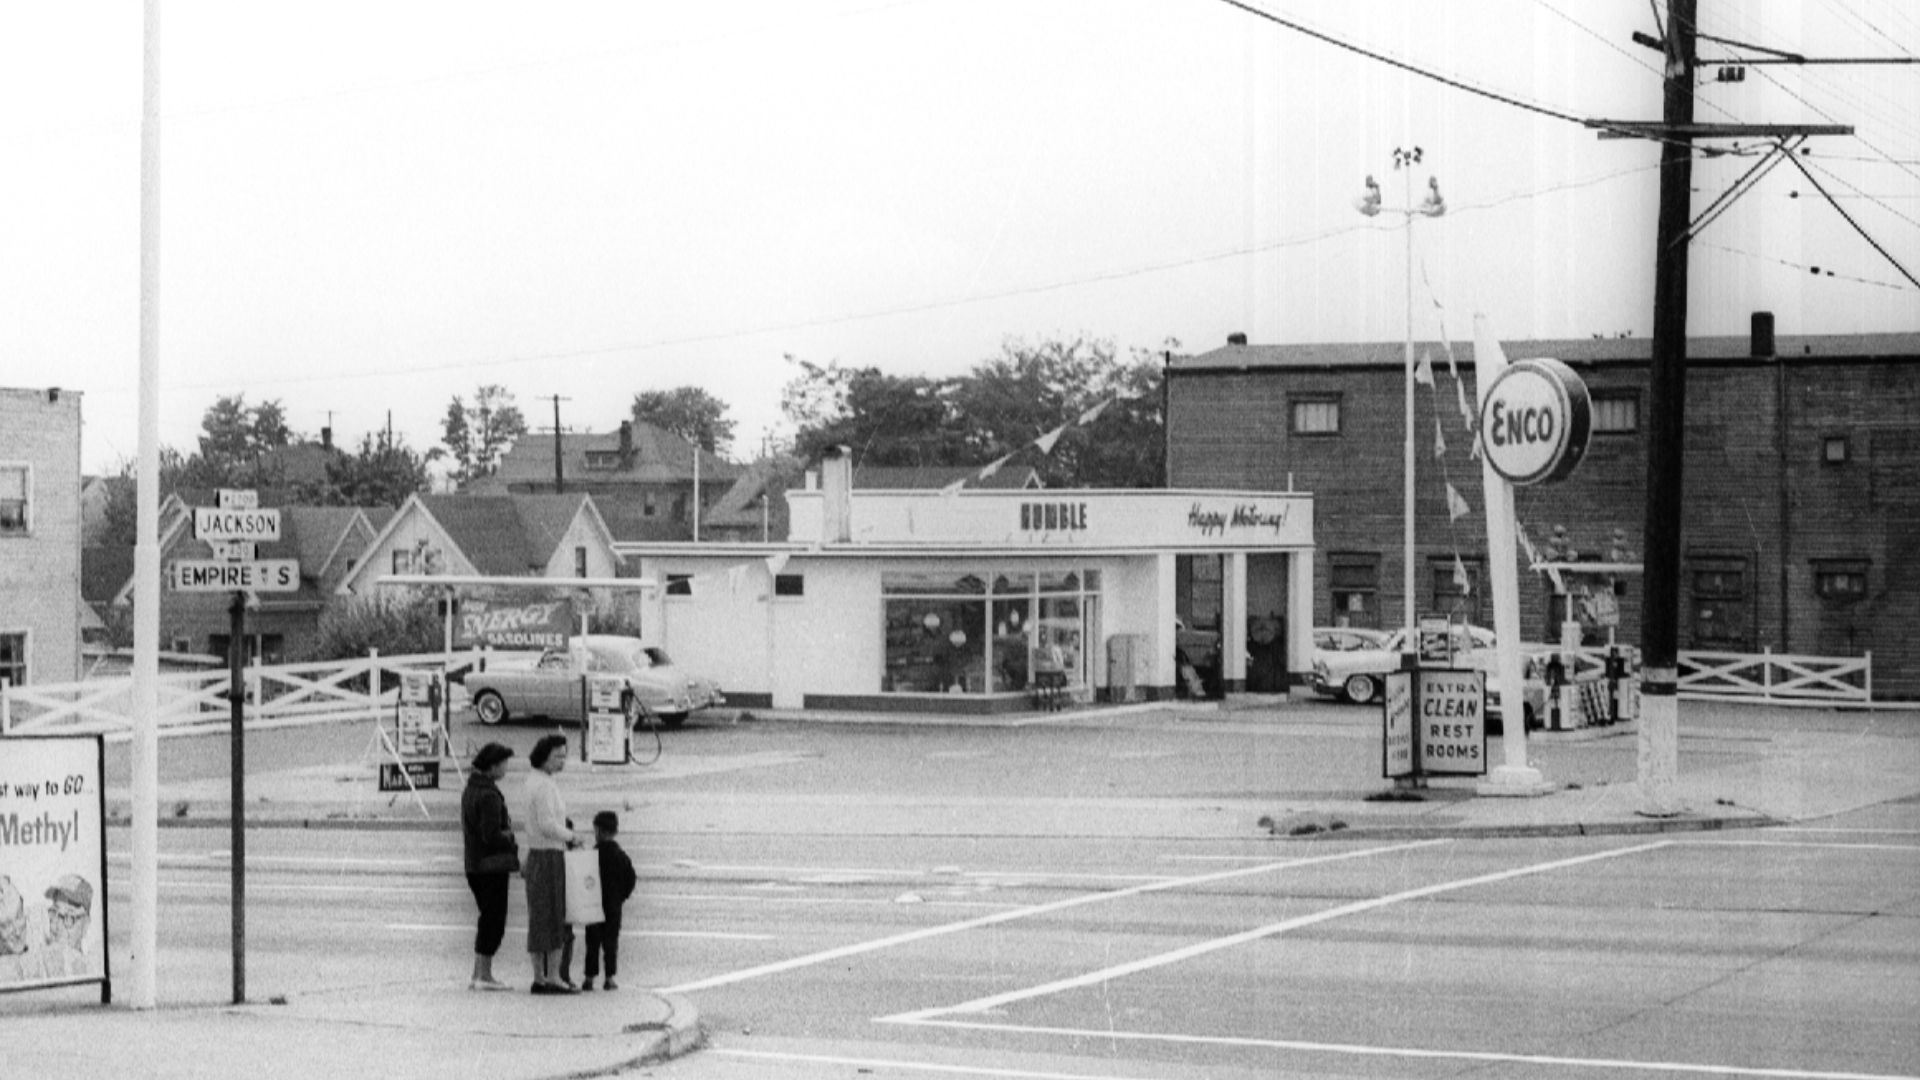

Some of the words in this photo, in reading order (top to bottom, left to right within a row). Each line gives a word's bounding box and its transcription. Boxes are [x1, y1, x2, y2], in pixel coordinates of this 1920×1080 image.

[1491, 400, 1554, 447] ENCO
[203, 515, 276, 533] JACKSON
[181, 567, 252, 586] EMPIRE
[277, 567, 291, 586] S
[1426, 682, 1478, 693] EXTRA
[1423, 698, 1478, 718] CLEAN
[1430, 723, 1475, 738] REST
[1426, 743, 1480, 759] ROOMS
[14, 784, 40, 801] way
[45, 780, 59, 796] to
[0, 809, 79, 852] Methyl
